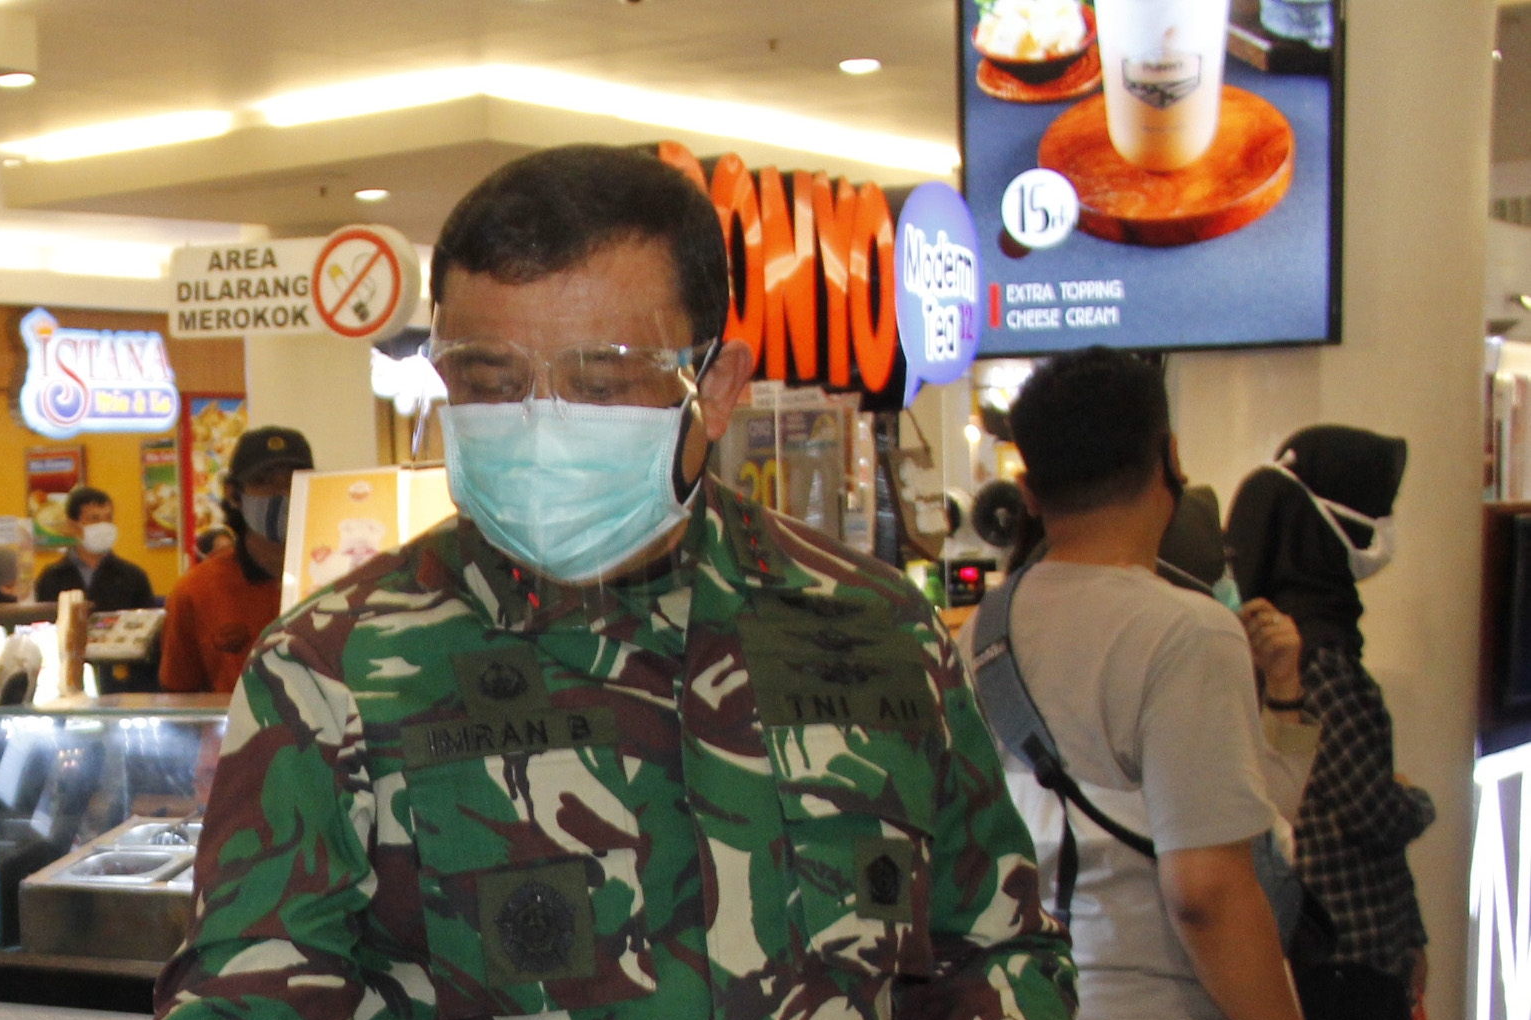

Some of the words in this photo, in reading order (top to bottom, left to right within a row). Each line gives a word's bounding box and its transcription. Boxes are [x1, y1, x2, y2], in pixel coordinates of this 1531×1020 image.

[208, 248, 278, 272] AREA
[904, 222, 975, 303] Modern
[177, 275, 309, 301] DILARANG
[1006, 282, 1056, 304] EXTRA
[1059, 279, 1125, 302] TOPPING
[177, 304, 310, 331] MEROKOK
[923, 294, 959, 361] Tea
[1006, 307, 1062, 329] CHEESE
[1065, 305, 1119, 327] CREAM
[37, 335, 175, 428] ISTANA
[785, 692, 850, 720] TNI
[428, 718, 549, 756] IMRAN
[568, 715, 592, 740] B
